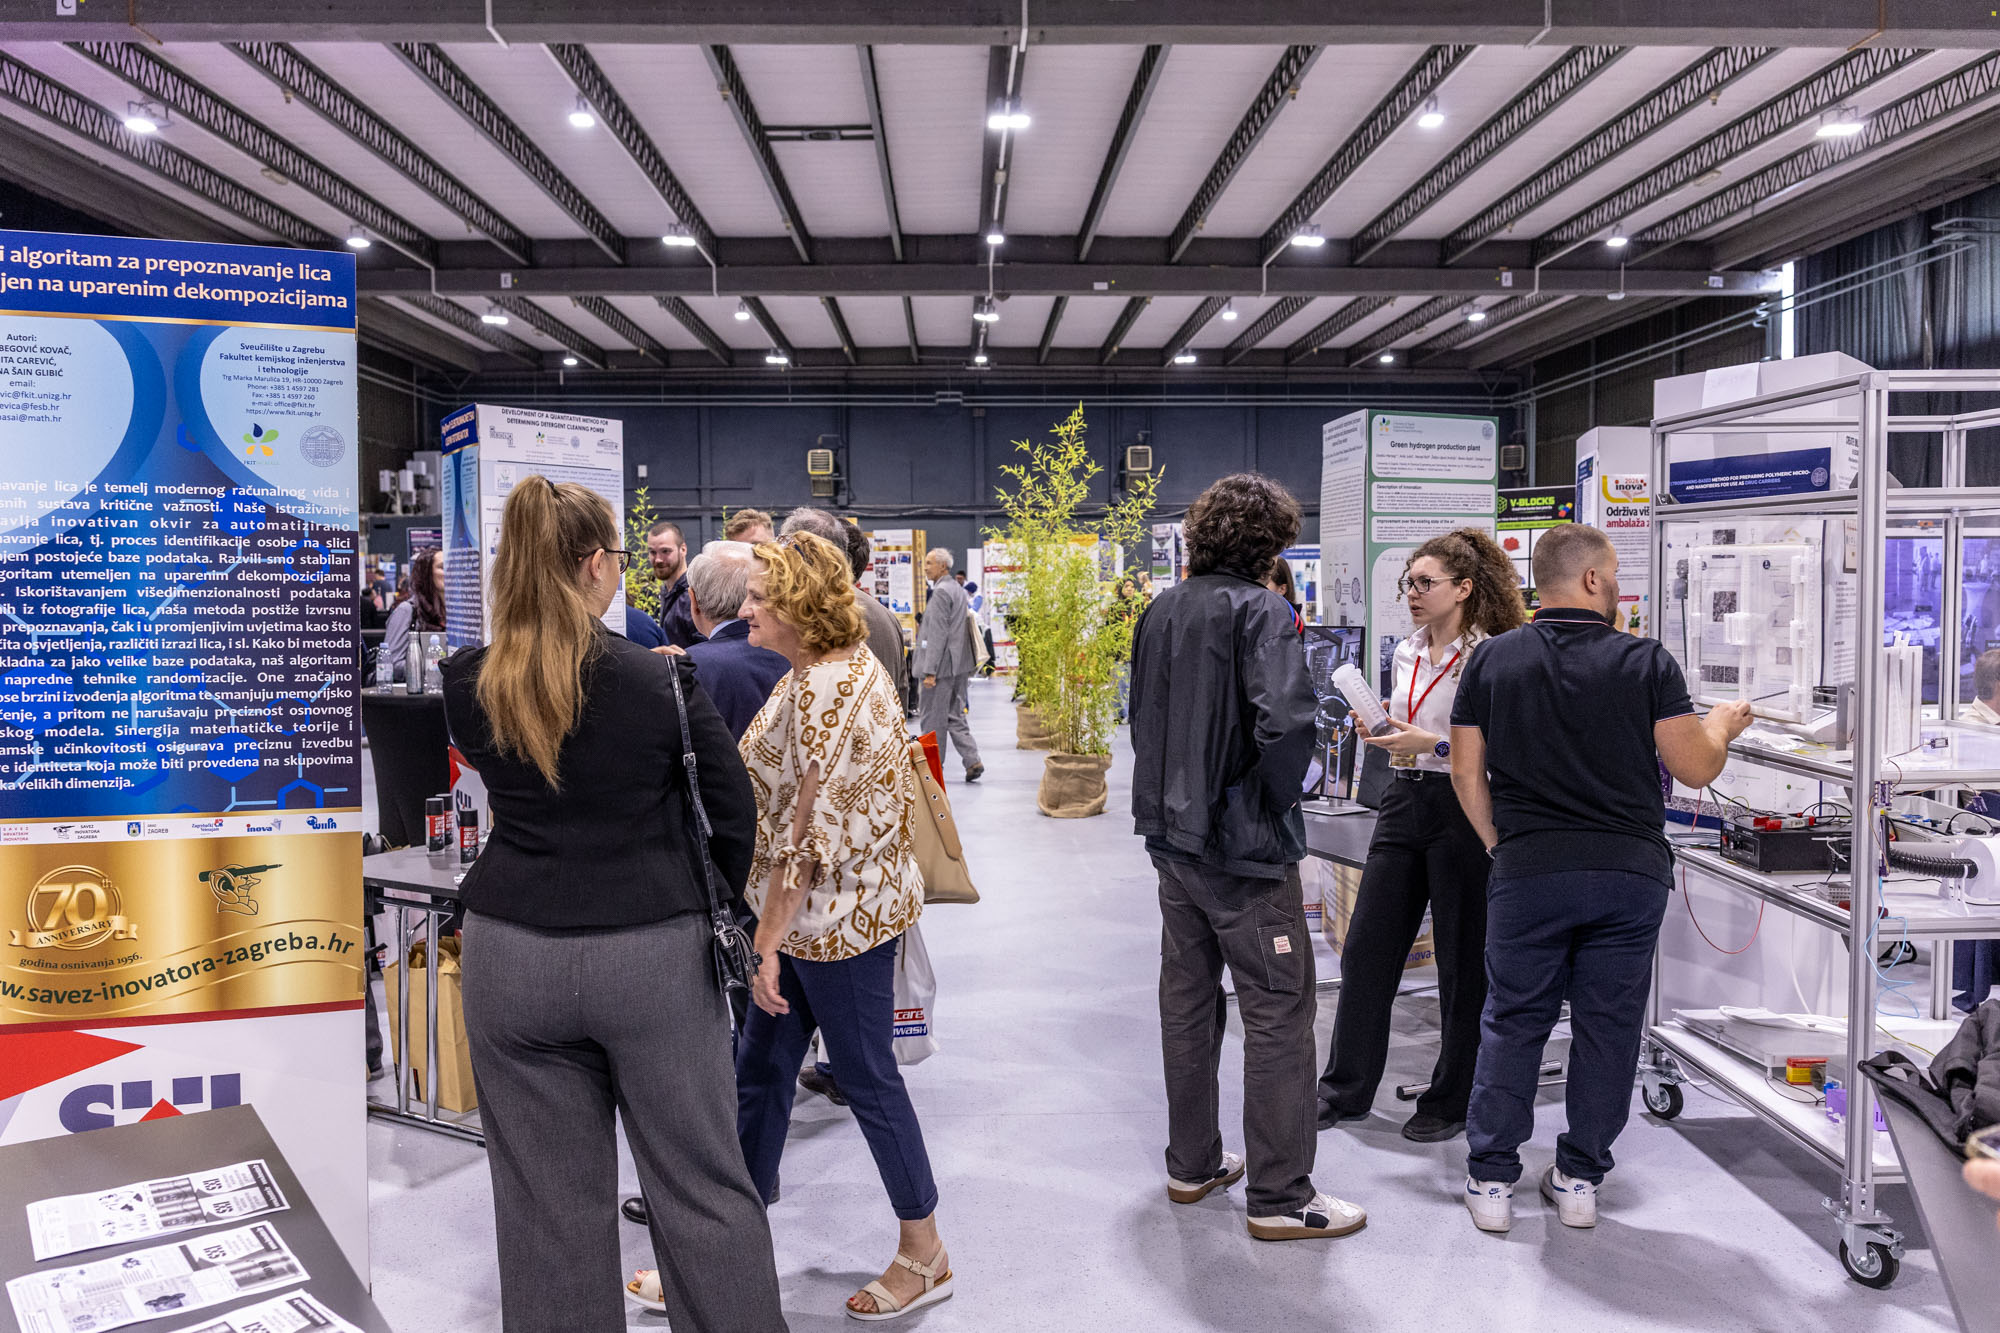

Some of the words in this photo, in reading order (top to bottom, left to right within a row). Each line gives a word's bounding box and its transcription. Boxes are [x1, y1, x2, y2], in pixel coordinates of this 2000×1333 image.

[10, 246, 112, 269] algoritam
[117, 250, 140, 270] za
[145, 252, 294, 281] prepoznavanje
[299, 263, 332, 282] lica
[38, 278, 64, 292] na
[69, 280, 168, 298] uparenim
[174, 281, 348, 309] dekompozicijama
[6, 334, 37, 342] Autori:
[40, 346, 72, 356] KOVAČ,
[240, 342, 283, 352] Sveučilište
[292, 346, 325, 354] Zagrebu
[16, 356, 56, 366] CAREVIĆ,
[220, 353, 252, 362] Fakultet
[255, 354, 296, 364] kemijskog
[298, 356, 346, 366] inženjerstva
[12, 366, 32, 376] ŠAIN
[35, 368, 64, 377] GLIBIĆ
[262, 366, 308, 376] tehnologije
[246, 408, 322, 417] https://www.fkit.unizg.hr
[502, 408, 536, 418] DEVELOPMENT
[551, 414, 582, 422] QUANTITATIVE
[582, 416, 600, 424] METHOD
[507, 418, 540, 426] DETERMINING
[541, 421, 566, 430] DETERGENT
[1390, 440, 1408, 448] Green
[1409, 441, 1436, 450] hydrogen
[1437, 442, 1466, 451] production
[1468, 444, 1480, 452] plant
[1615, 480, 1642, 490] inova
[1510, 496, 1555, 506] V-BLOCKS
[1606, 506, 1638, 516] Održiva
[1606, 518, 1645, 528] ambalaža
[35, 551, 102, 565] postojeće
[108, 551, 140, 563] baze
[146, 551, 212, 566] podataka.
[219, 552, 261, 564] Razvili
[267, 555, 294, 564] smo
[300, 552, 350, 564] stabilan
[62, 568, 130, 583] utemeljen
[140, 572, 155, 580] na
[165, 569, 228, 584] uparenim
[238, 569, 350, 585] dekompozicijama
[16, 585, 126, 600] Iskorištavanjem
[137, 586, 280, 598] višedimenzionalnosti
[290, 586, 351, 601] podataka
[3, 620, 108, 635] prepoznavanja,
[111, 620, 134, 632] čak
[137, 620, 141, 632] i
[144, 624, 152, 632] u
[155, 620, 243, 635] promjenjivim
[247, 620, 303, 635] uvjetima
[306, 620, 329, 632] kao
[332, 620, 351, 632] što
[5, 672, 72, 687] napredne
[83, 672, 136, 684] tehnike
[147, 671, 246, 686] randomizacije.
[257, 671, 284, 682] One
[295, 670, 352, 685] značajno
[54, 739, 146, 753] učinkovitosti
[157, 739, 224, 753] osigurava
[234, 737, 292, 752] preciznu
[302, 735, 353, 748] izvedbu
[18, 776, 62, 789] velikih
[66, 775, 134, 790] dimenzija.
[246, 824, 272, 832] inova
[38, 882, 109, 930] 70
[102, 878, 112, 889] th
[36, 920, 114, 946] ANNIVERSARY
[20, 958, 58, 968] godina
[60, 958, 114, 969] osnivanja
[117, 952, 143, 966] 1956.
[0, 932, 354, 1004] w.savez-inovatora-zagreba.hr
